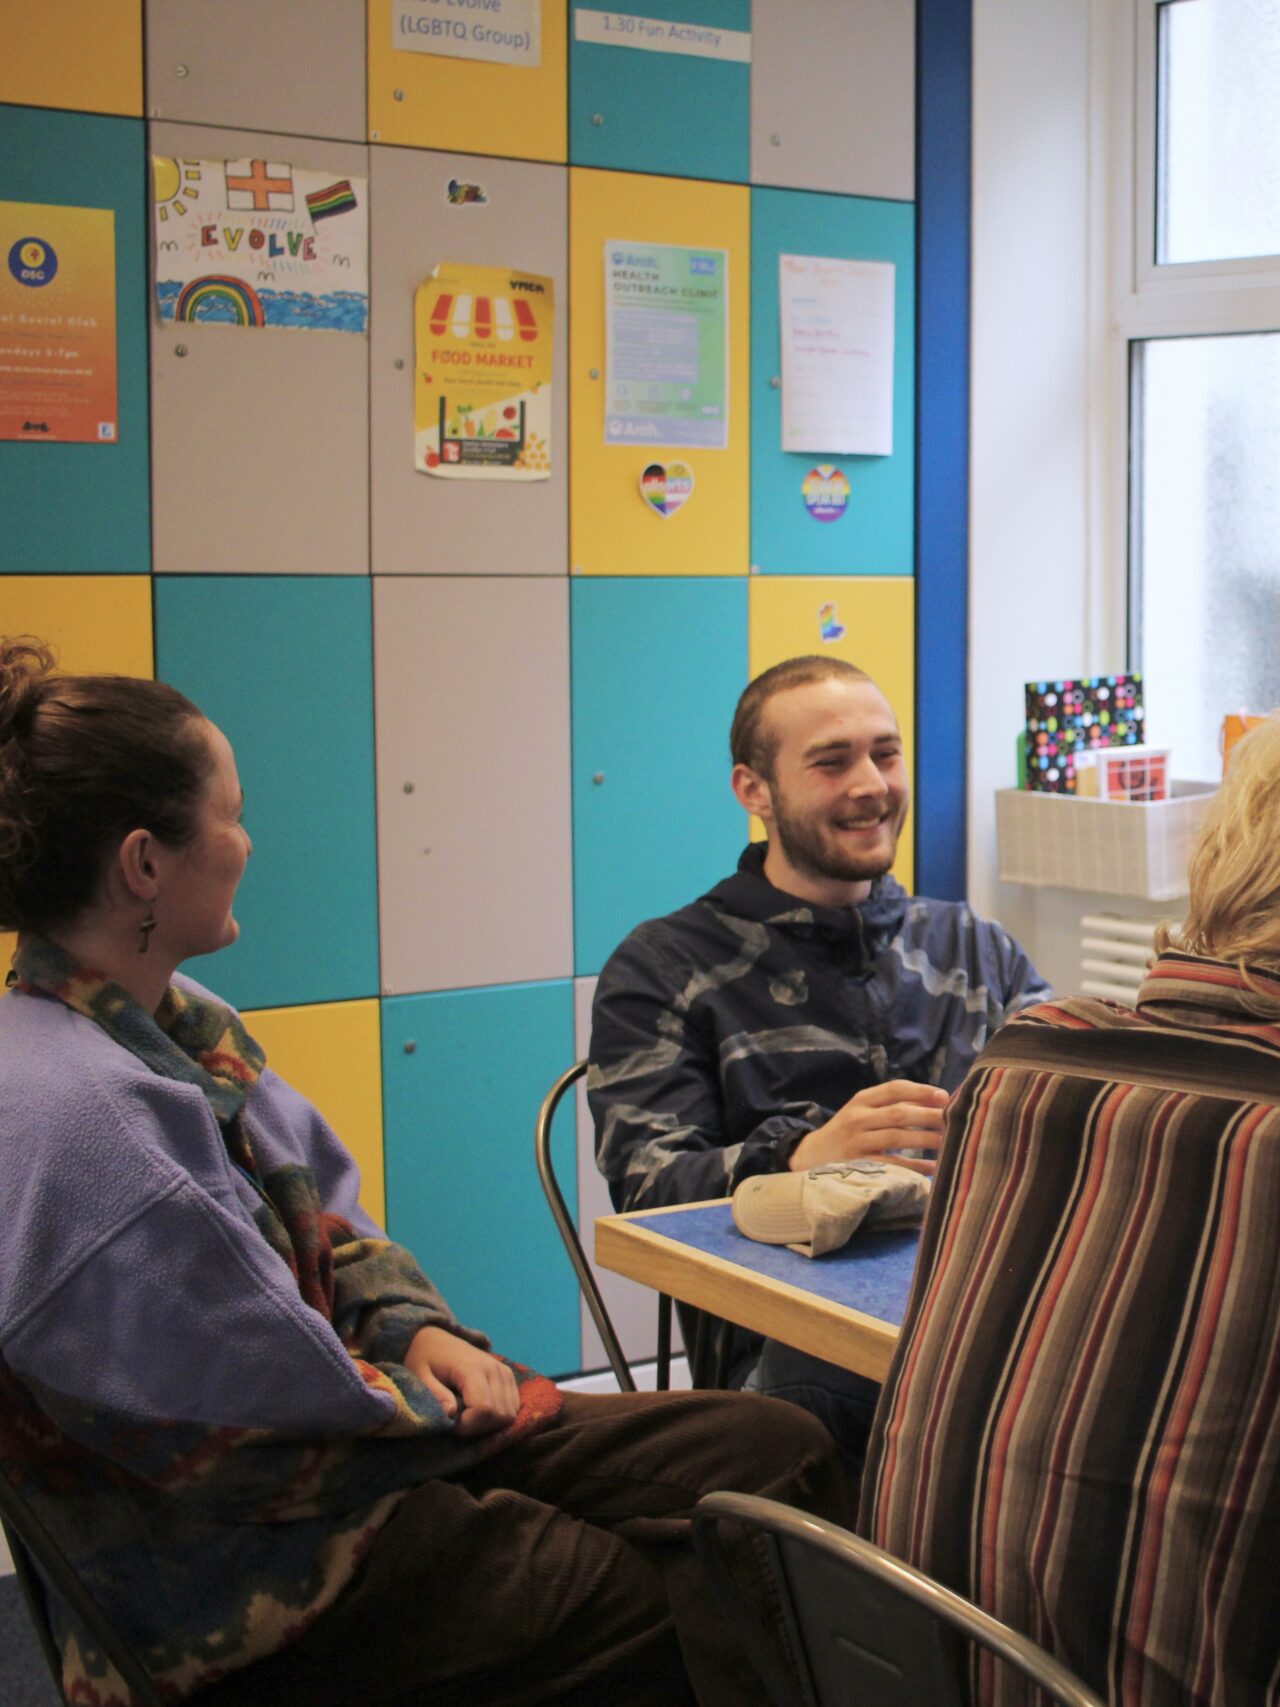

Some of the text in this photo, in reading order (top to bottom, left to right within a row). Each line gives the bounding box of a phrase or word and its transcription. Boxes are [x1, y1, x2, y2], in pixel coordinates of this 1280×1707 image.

[401, 14, 530, 50] (LGBTQ Group)
[604, 15, 721, 47] 1.30 Fun Activity
[201, 225, 317, 260] EVOLVE
[432, 349, 534, 369] FOOD MARKET
